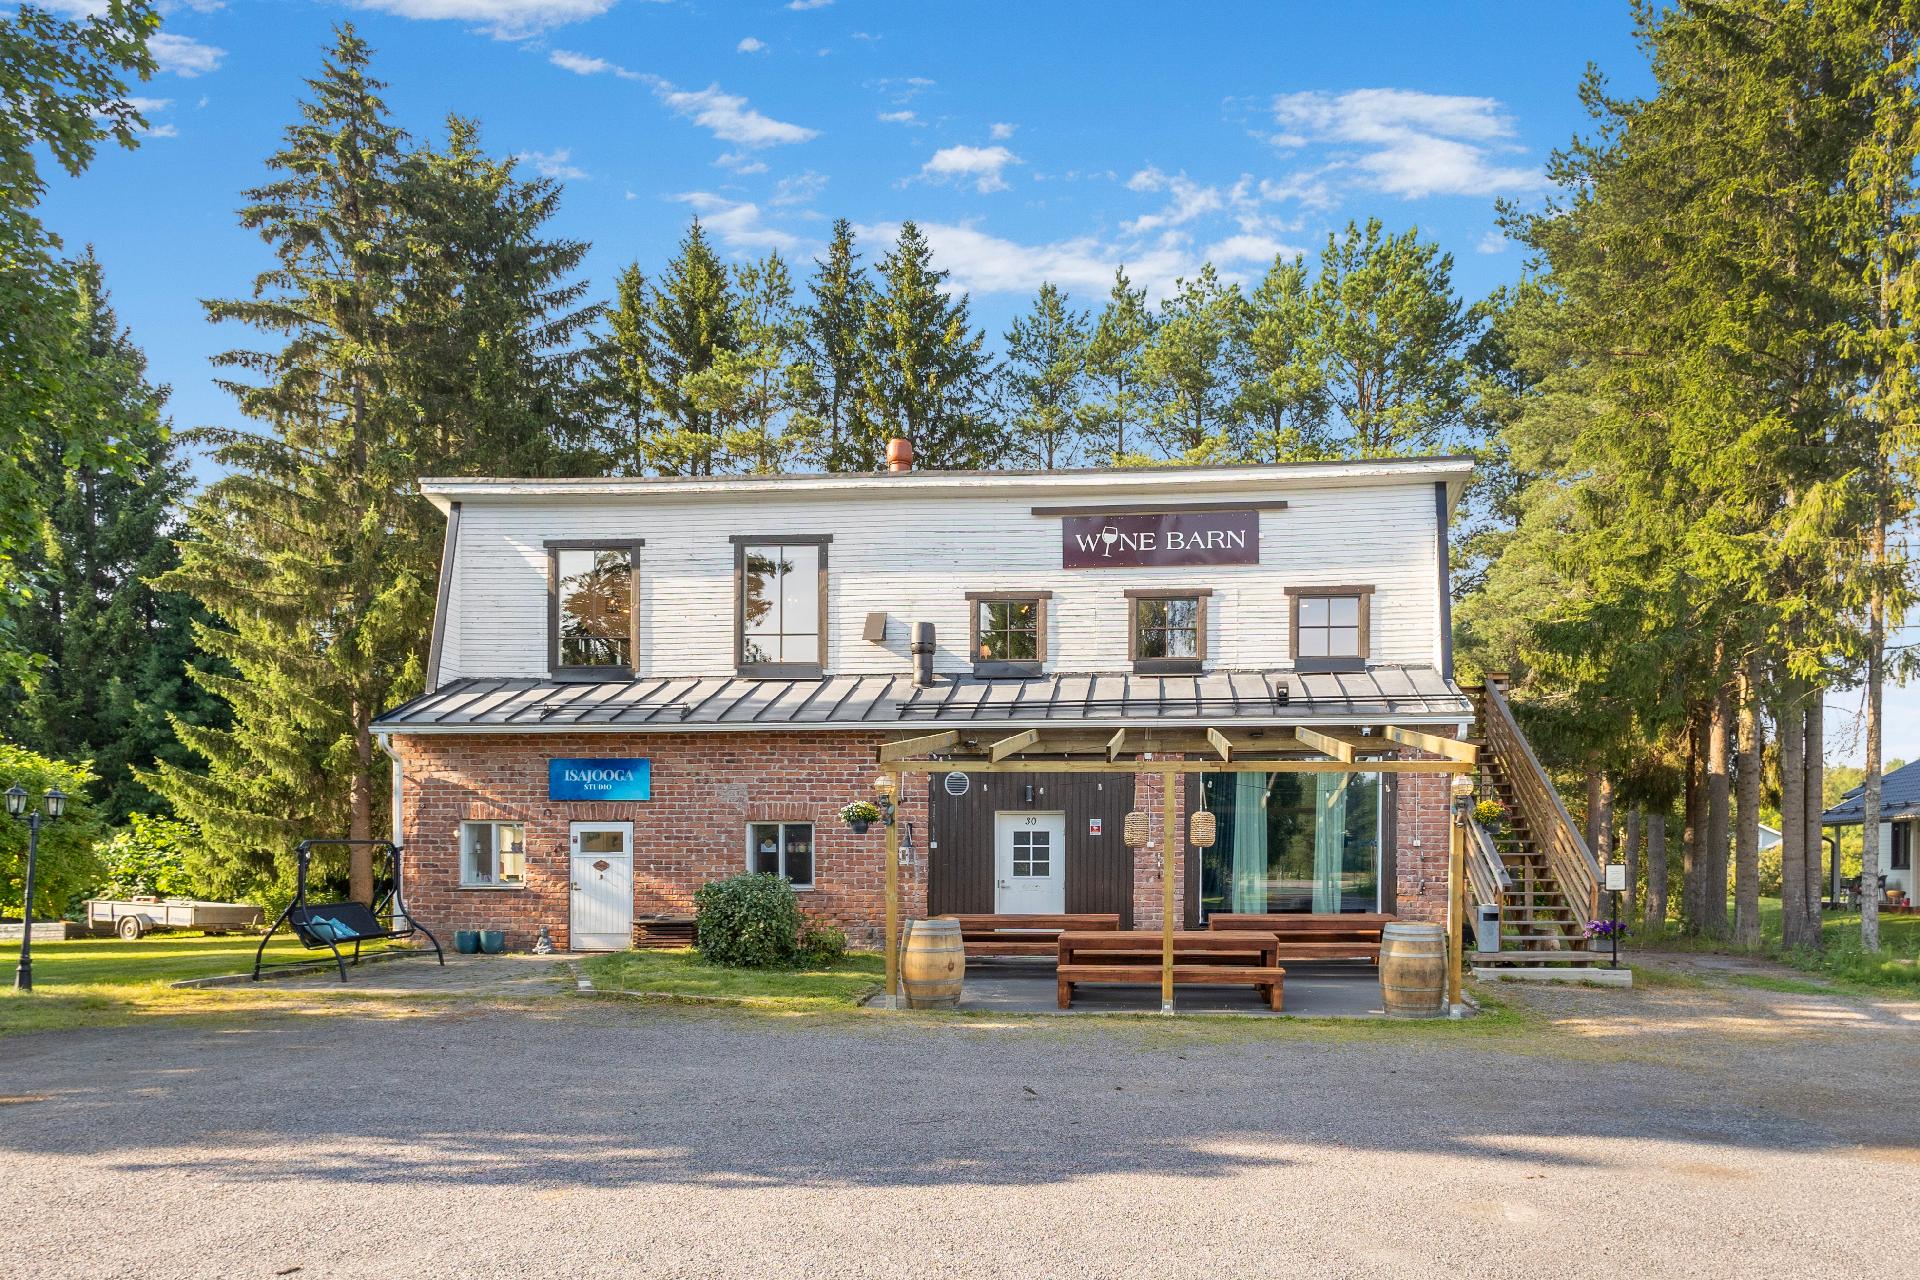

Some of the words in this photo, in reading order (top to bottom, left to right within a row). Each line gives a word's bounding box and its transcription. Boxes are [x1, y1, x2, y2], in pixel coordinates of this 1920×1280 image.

[1166, 530, 1246, 550] BARN
[564, 769, 634, 783] ISAJOOGA
[1025, 816, 1037, 825] 30
